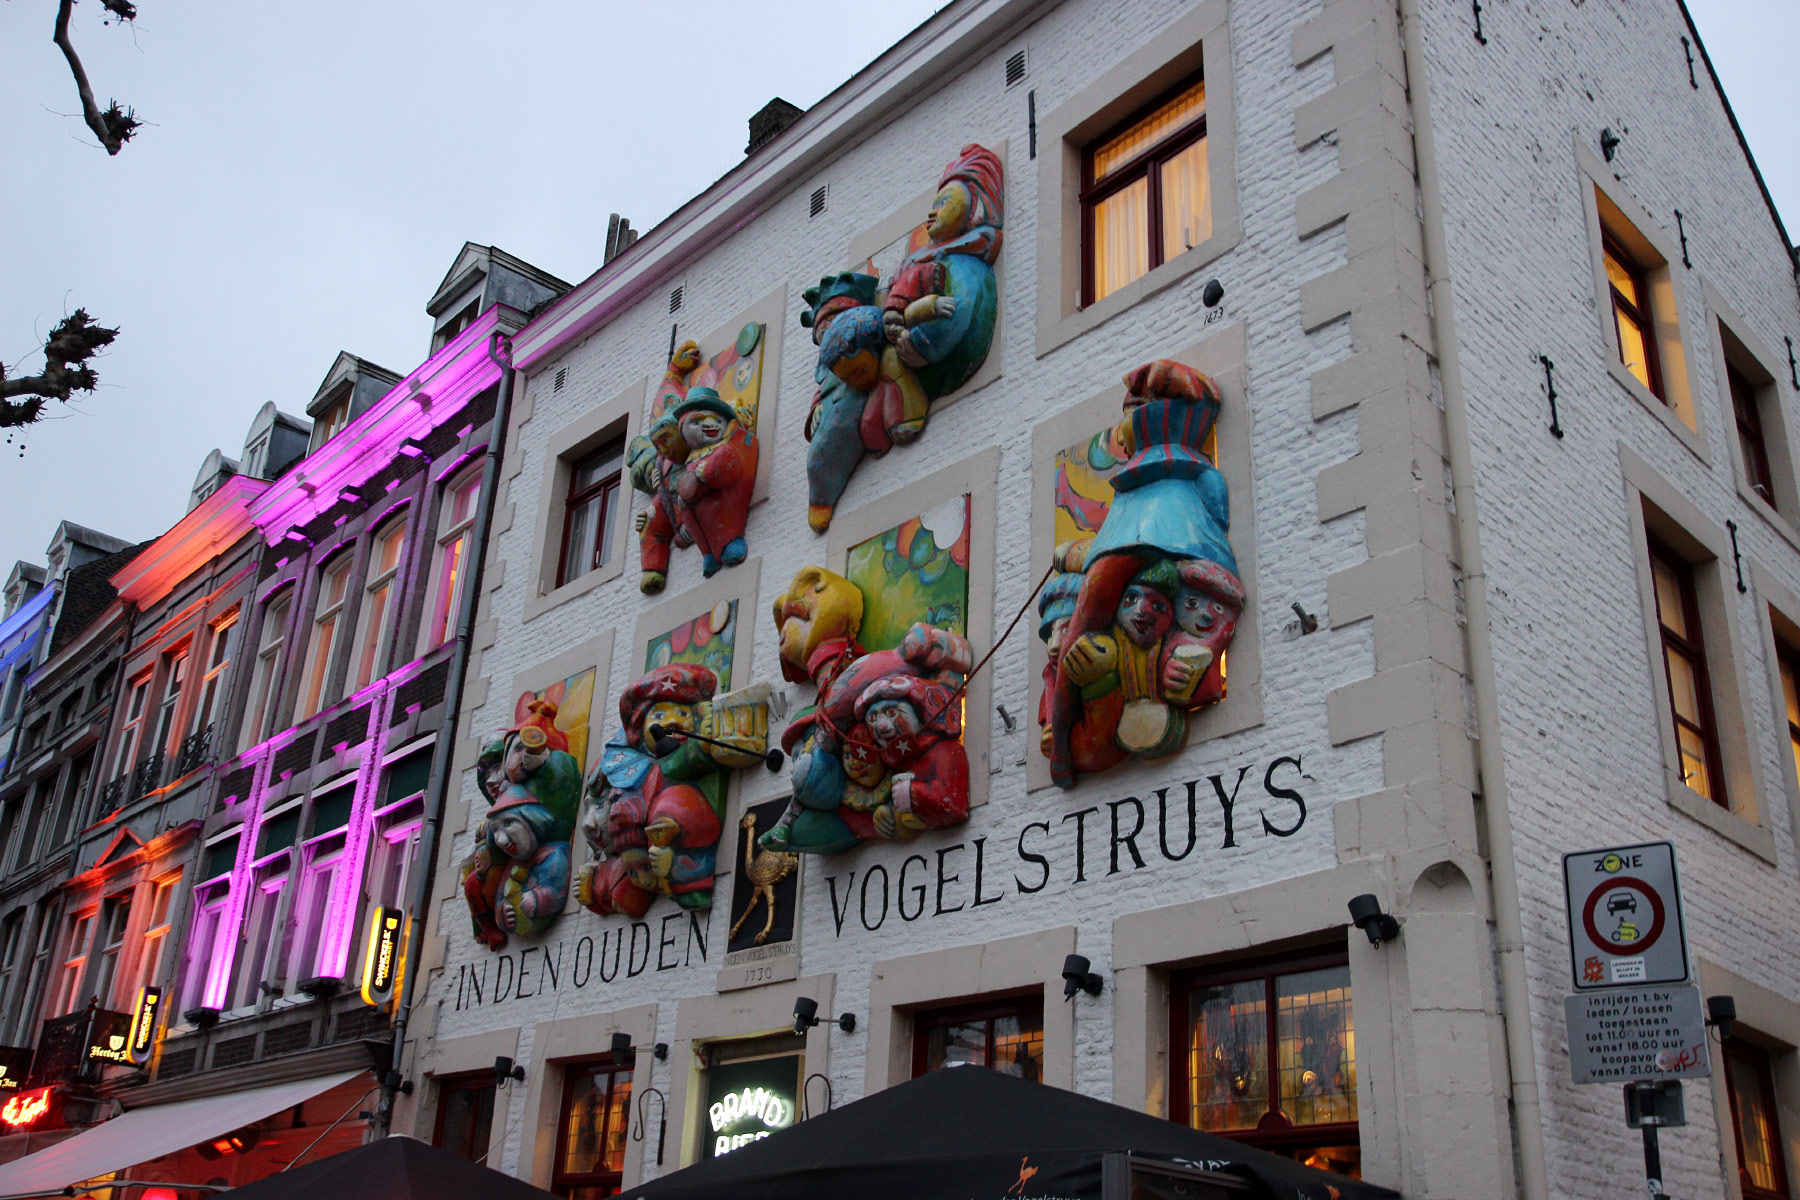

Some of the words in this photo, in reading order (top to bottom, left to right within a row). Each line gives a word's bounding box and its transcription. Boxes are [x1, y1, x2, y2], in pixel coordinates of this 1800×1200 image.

[1203, 306, 1224, 326] 1673
[1593, 854, 1643, 873] ZNE
[455, 959, 488, 1011] IN
[493, 941, 563, 1004] DEN
[573, 907, 712, 988] OUDEN
[745, 966, 773, 982] 1730
[1586, 1008, 1620, 1018] laden
[1623, 1006, 1629, 1016] /
[1632, 1004, 1673, 1015] lossen
[1599, 1017, 1668, 1029] toegestaan
[1585, 1032, 1603, 1041] tot
[1638, 1029, 1661, 1038] uur
[1665, 1028, 1680, 1036] en
[1588, 1043, 1622, 1053] vanaf
[1627, 1040, 1658, 1050] 18.00
[1662, 1040, 1684, 1048] uur
[1590, 1066, 1625, 1076] vanaf
[708, 1086, 783, 1132] BRAND
